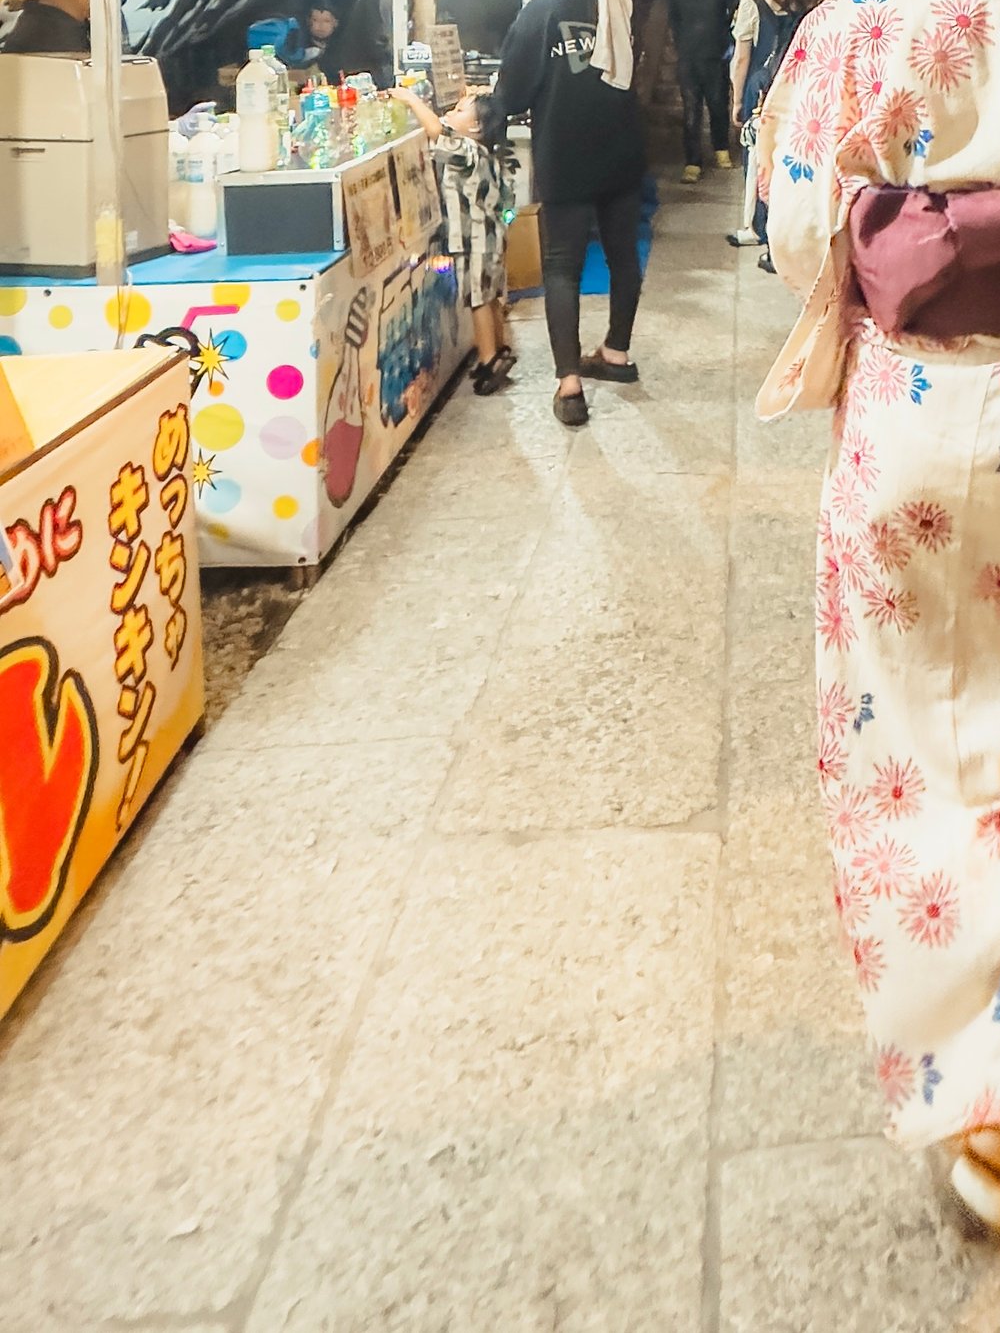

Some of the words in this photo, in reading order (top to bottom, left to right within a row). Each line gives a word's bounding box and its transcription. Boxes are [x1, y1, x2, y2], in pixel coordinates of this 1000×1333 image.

[551, 36, 596, 58] NEW
[152, 402, 190, 672] めっちゃ
